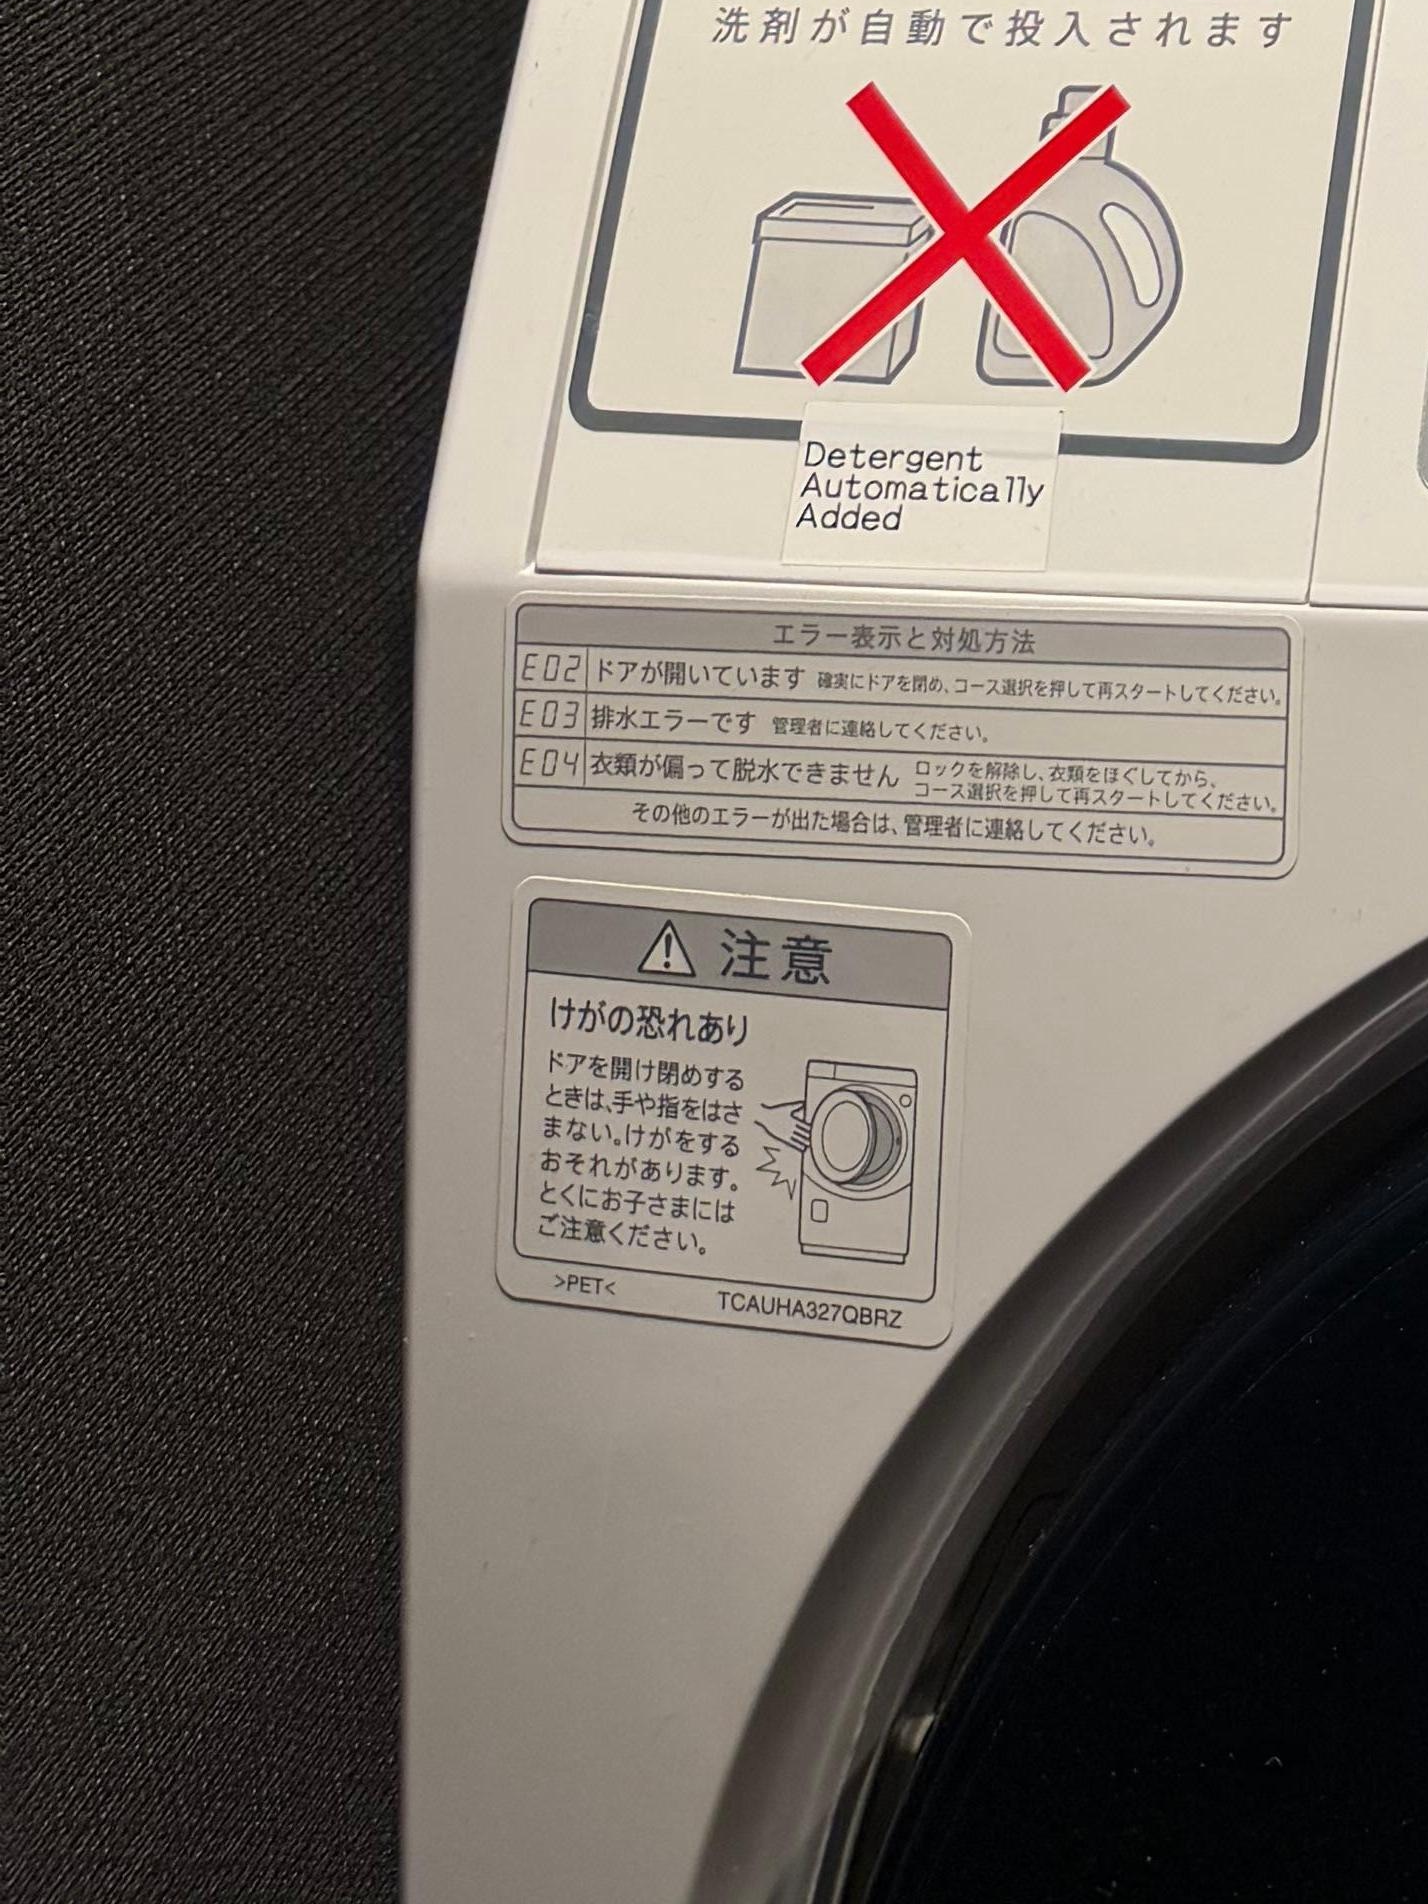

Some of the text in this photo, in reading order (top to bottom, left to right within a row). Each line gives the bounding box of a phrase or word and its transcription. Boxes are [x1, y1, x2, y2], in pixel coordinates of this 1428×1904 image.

[713, 6, 1294, 49] 洗剤が自動で投入されます
[803, 442, 984, 475] Detergent
[800, 474, 1044, 509] Automatically
[796, 504, 904, 534] Added
[772, 624, 1037, 655] エラー表示と対処方法
[520, 653, 806, 692] E02 ドアが開いています
[519, 699, 754, 737] E03 排水エラーです
[519, 747, 901, 790] E04 衣類が偏って脱水できません
[720, 928, 833, 985] 注意
[550, 996, 749, 1047] けがの恐れあり
[717, 1291, 904, 1329] TCAUHA327QBRZ
